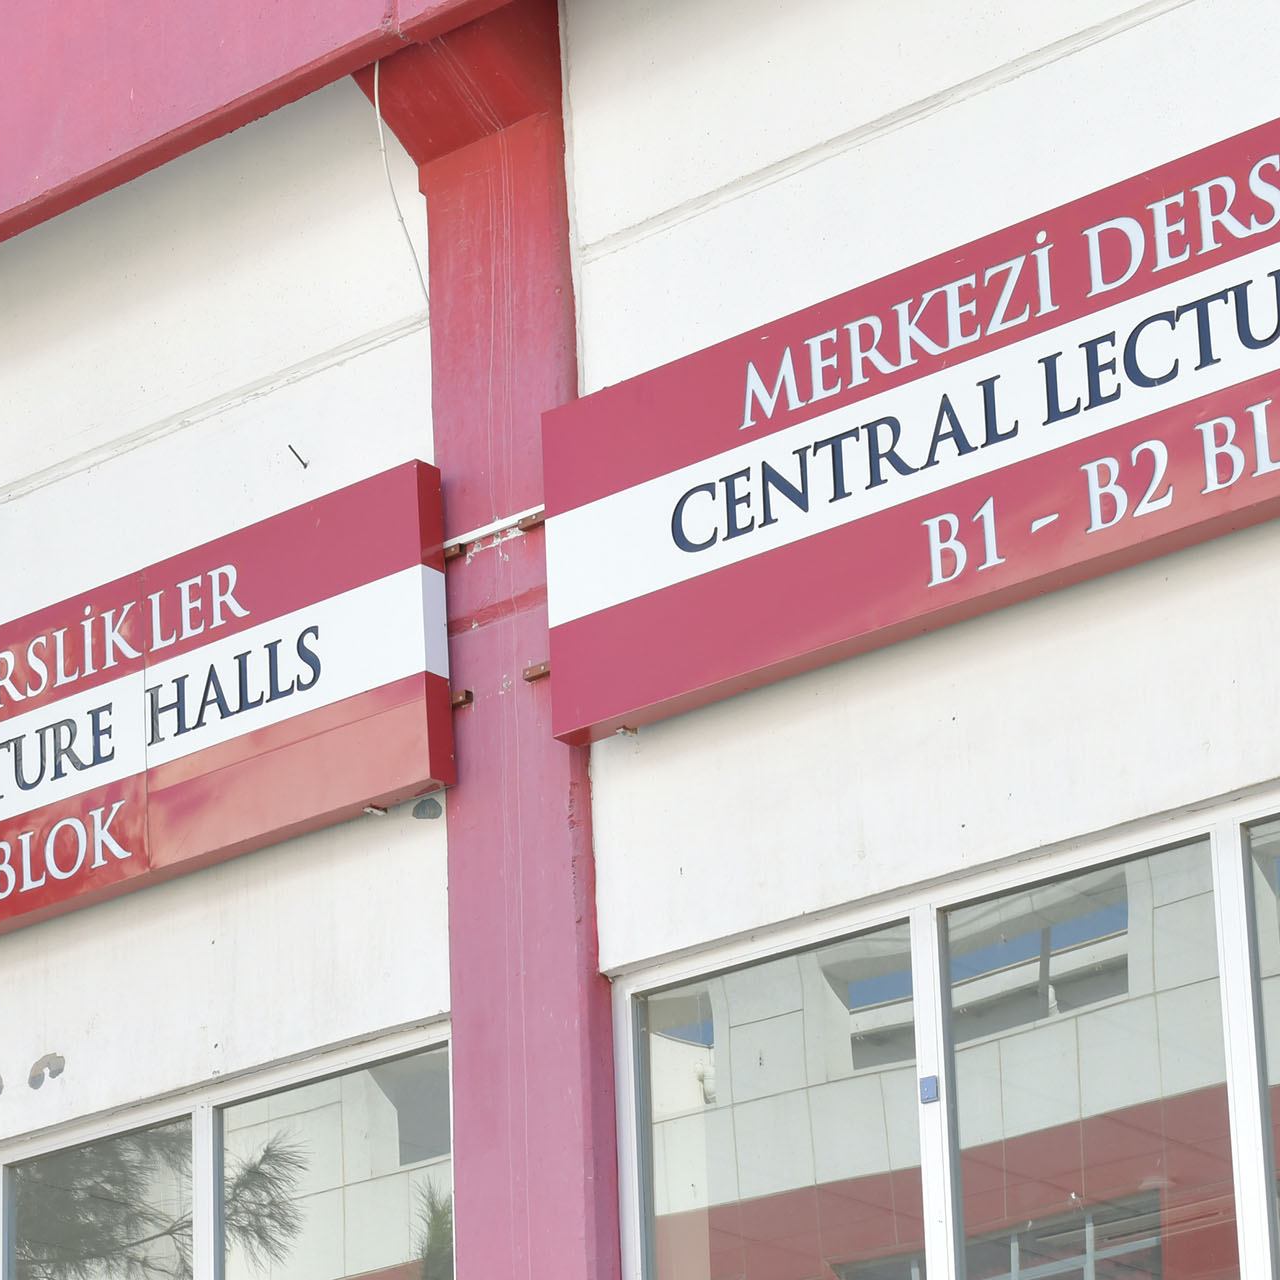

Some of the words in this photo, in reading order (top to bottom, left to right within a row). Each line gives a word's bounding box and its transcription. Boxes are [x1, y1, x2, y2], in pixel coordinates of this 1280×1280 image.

[739, 230, 1061, 430] MERKEZİ
[671, 375, 1020, 553] CENTRAL
[923, 496, 1006, 589] B1
[1031, 513, 1061, 534] -
[1080, 439, 1174, 533] B2
[145, 625, 321, 745] HALLS
